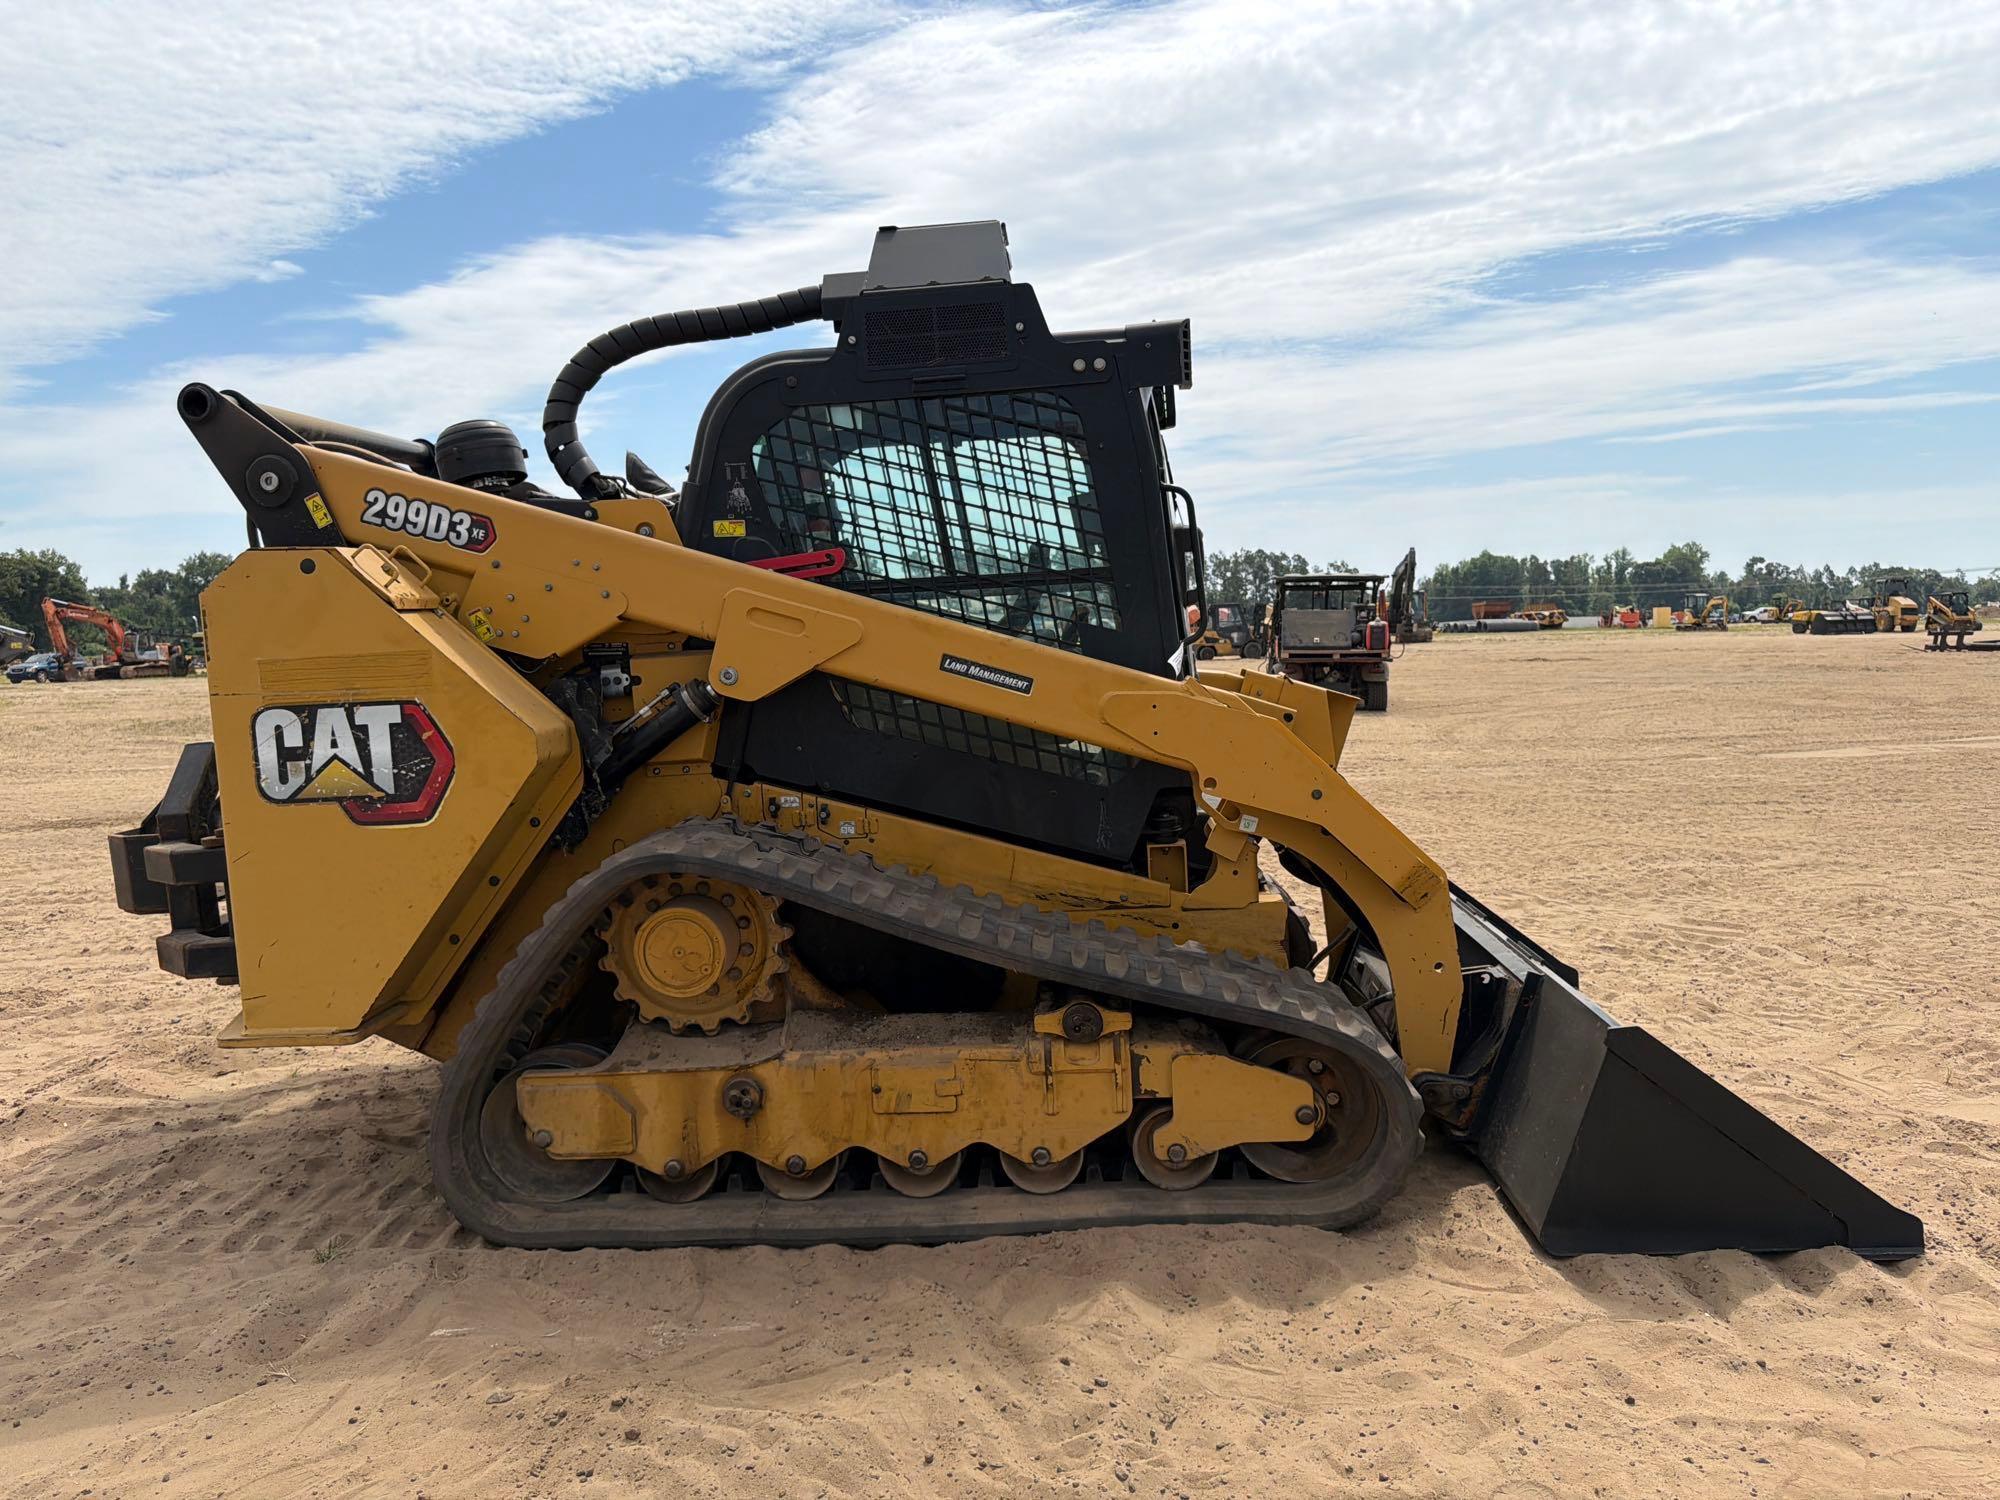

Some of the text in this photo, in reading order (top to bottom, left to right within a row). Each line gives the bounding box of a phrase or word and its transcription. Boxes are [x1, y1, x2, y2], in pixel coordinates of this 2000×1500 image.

[362, 489, 486, 546] 299D3 XE
[944, 658, 1030, 690] LAND MANAGEMENT
[255, 704, 402, 800] CAT
